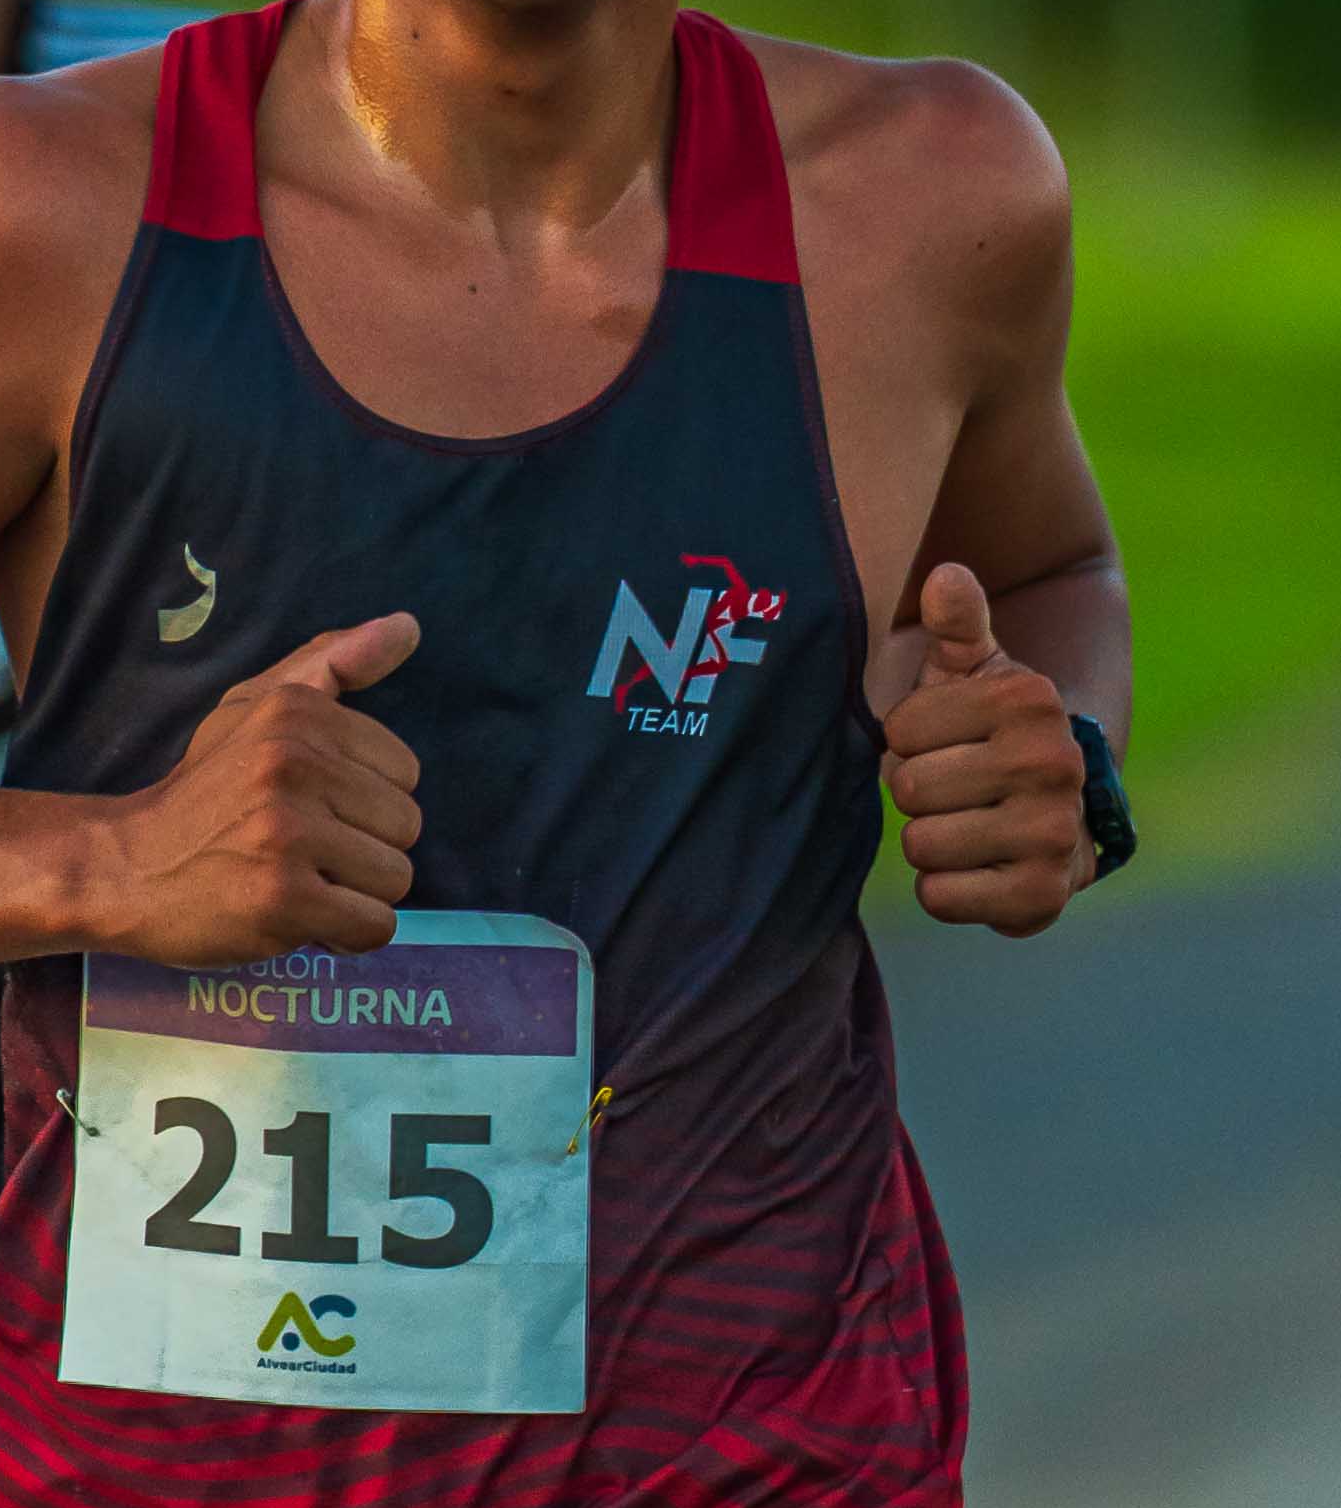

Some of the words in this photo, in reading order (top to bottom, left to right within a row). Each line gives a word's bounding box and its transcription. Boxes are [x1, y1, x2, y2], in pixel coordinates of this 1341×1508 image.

[627, 707, 708, 737] TEAM
[187, 975, 453, 1026] NOCTURNA
[144, 1096, 494, 1269] 215
[257, 1357, 357, 1374] AlvearCiudad
